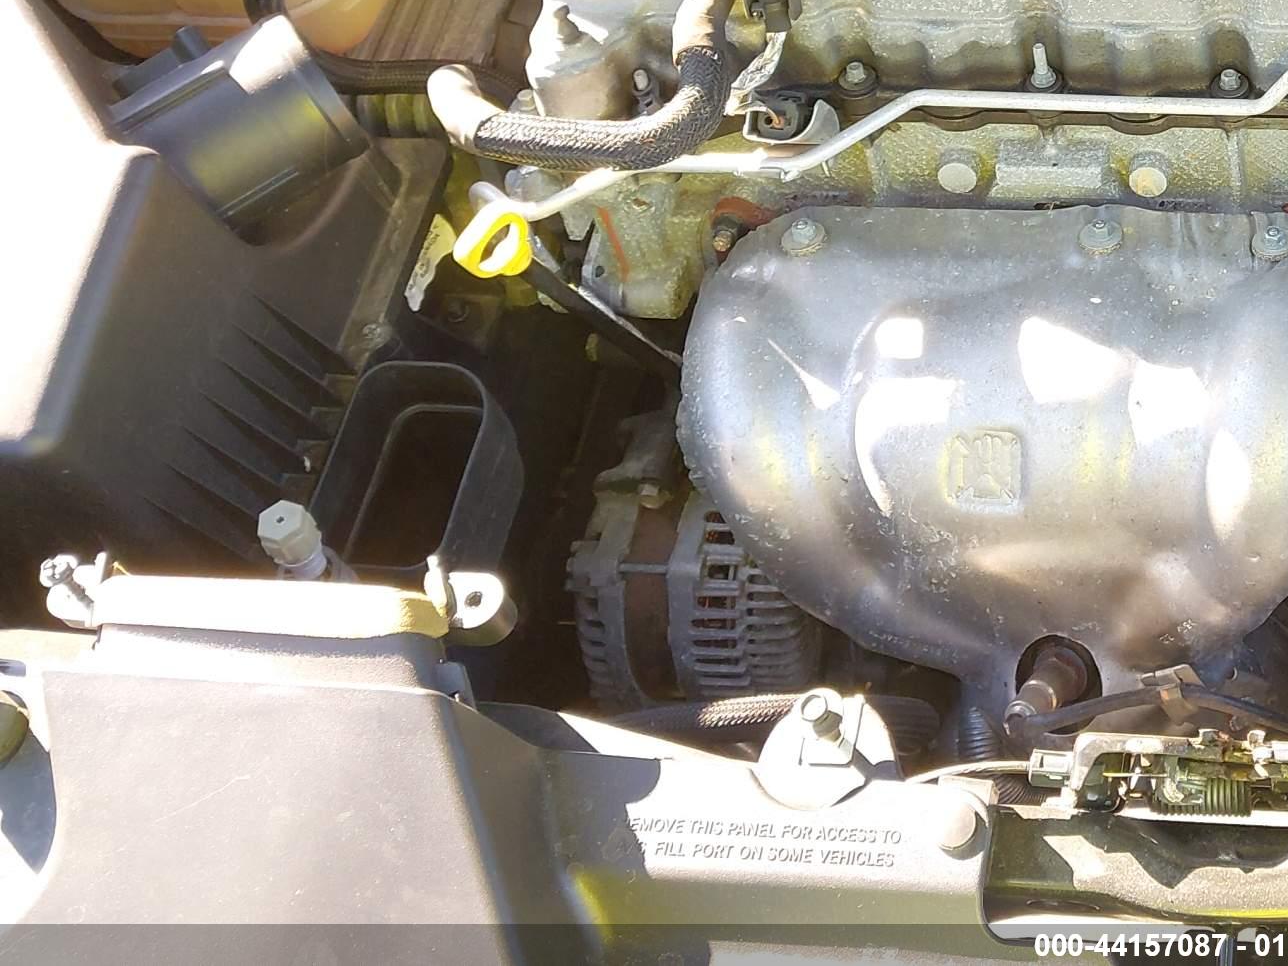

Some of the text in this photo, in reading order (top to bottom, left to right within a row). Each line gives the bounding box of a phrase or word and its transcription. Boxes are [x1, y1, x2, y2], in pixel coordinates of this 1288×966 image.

[690, 820, 723, 836] THIS
[727, 822, 776, 838] PANEL
[781, 825, 813, 839] FOR
[816, 826, 878, 843] ACCESS
[882, 830, 902, 844] TO
[655, 842, 686, 857] FILL
[692, 844, 735, 858] PORT
[740, 846, 763, 860] ON
[767, 847, 814, 863] SOME
[820, 850, 895, 867] VEHICLES
